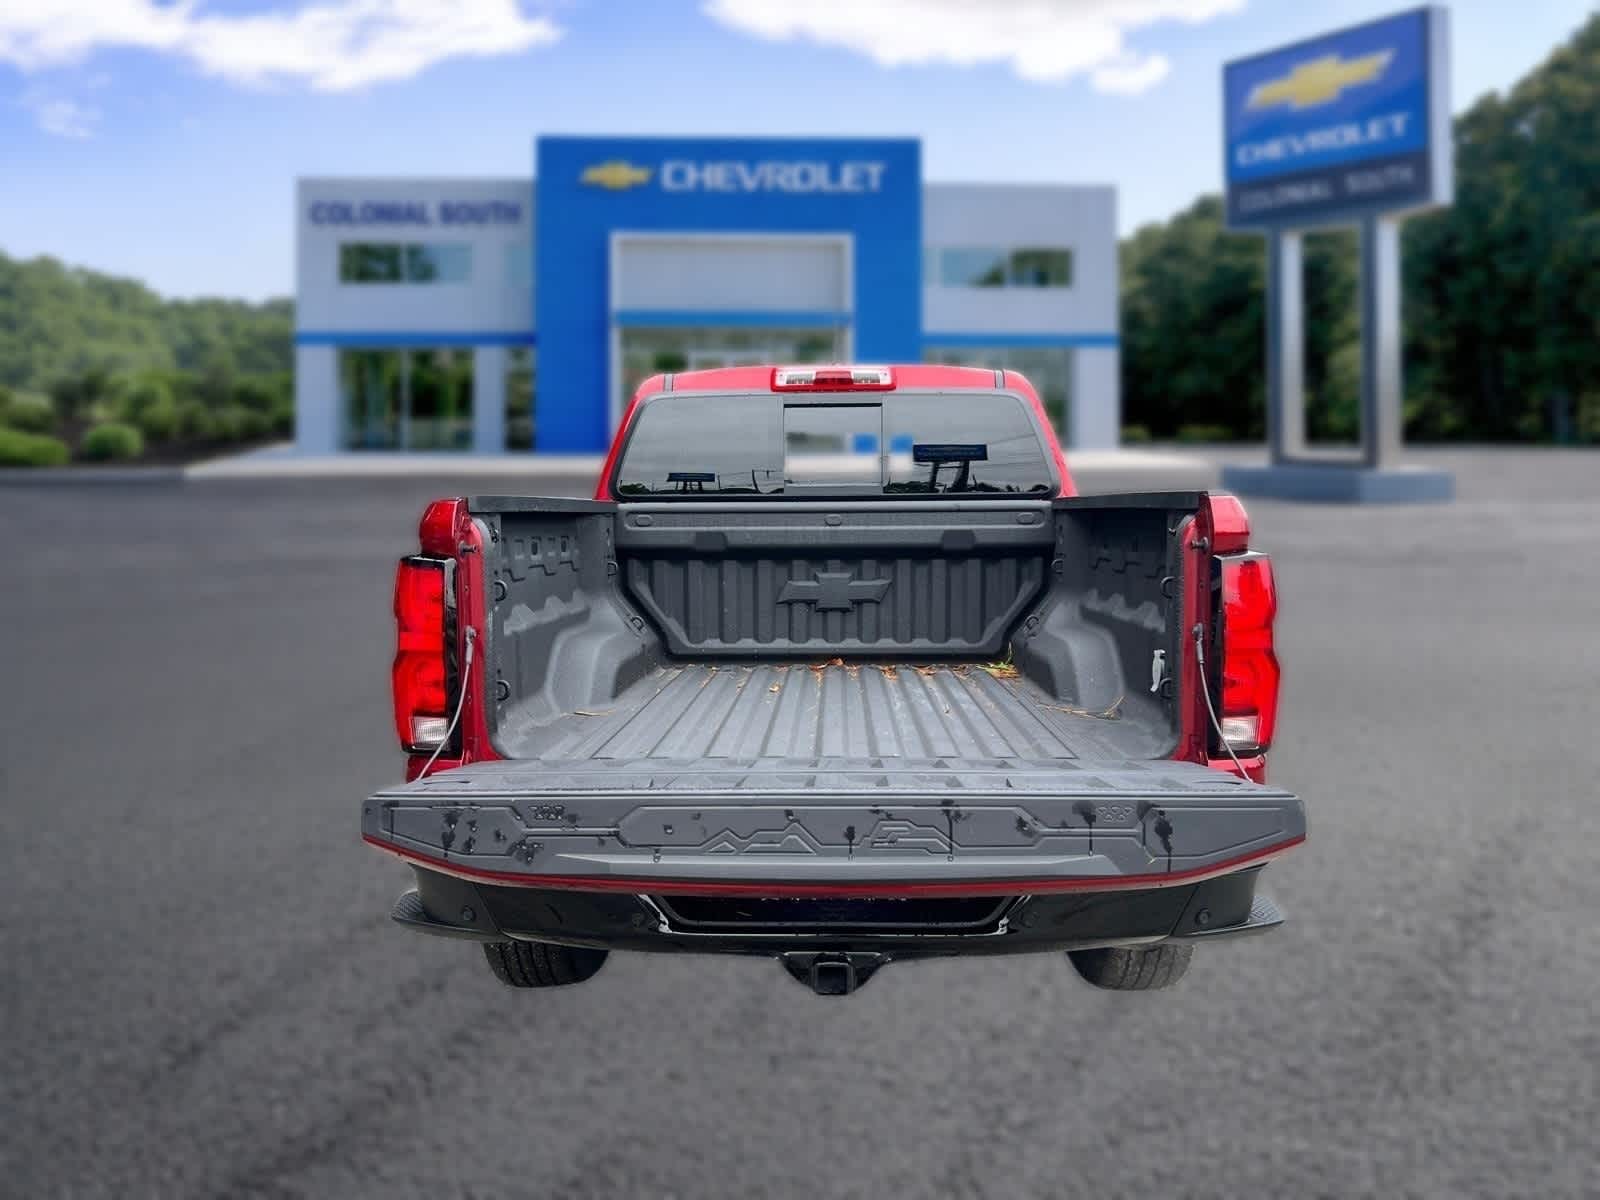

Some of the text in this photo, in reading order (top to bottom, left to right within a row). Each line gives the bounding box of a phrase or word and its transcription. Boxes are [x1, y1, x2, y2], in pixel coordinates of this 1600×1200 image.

[1236, 113, 1411, 167] CHEVROLET
[661, 160, 885, 193] CHEVROLET
[309, 201, 522, 225] COLONIAL SOUTH
